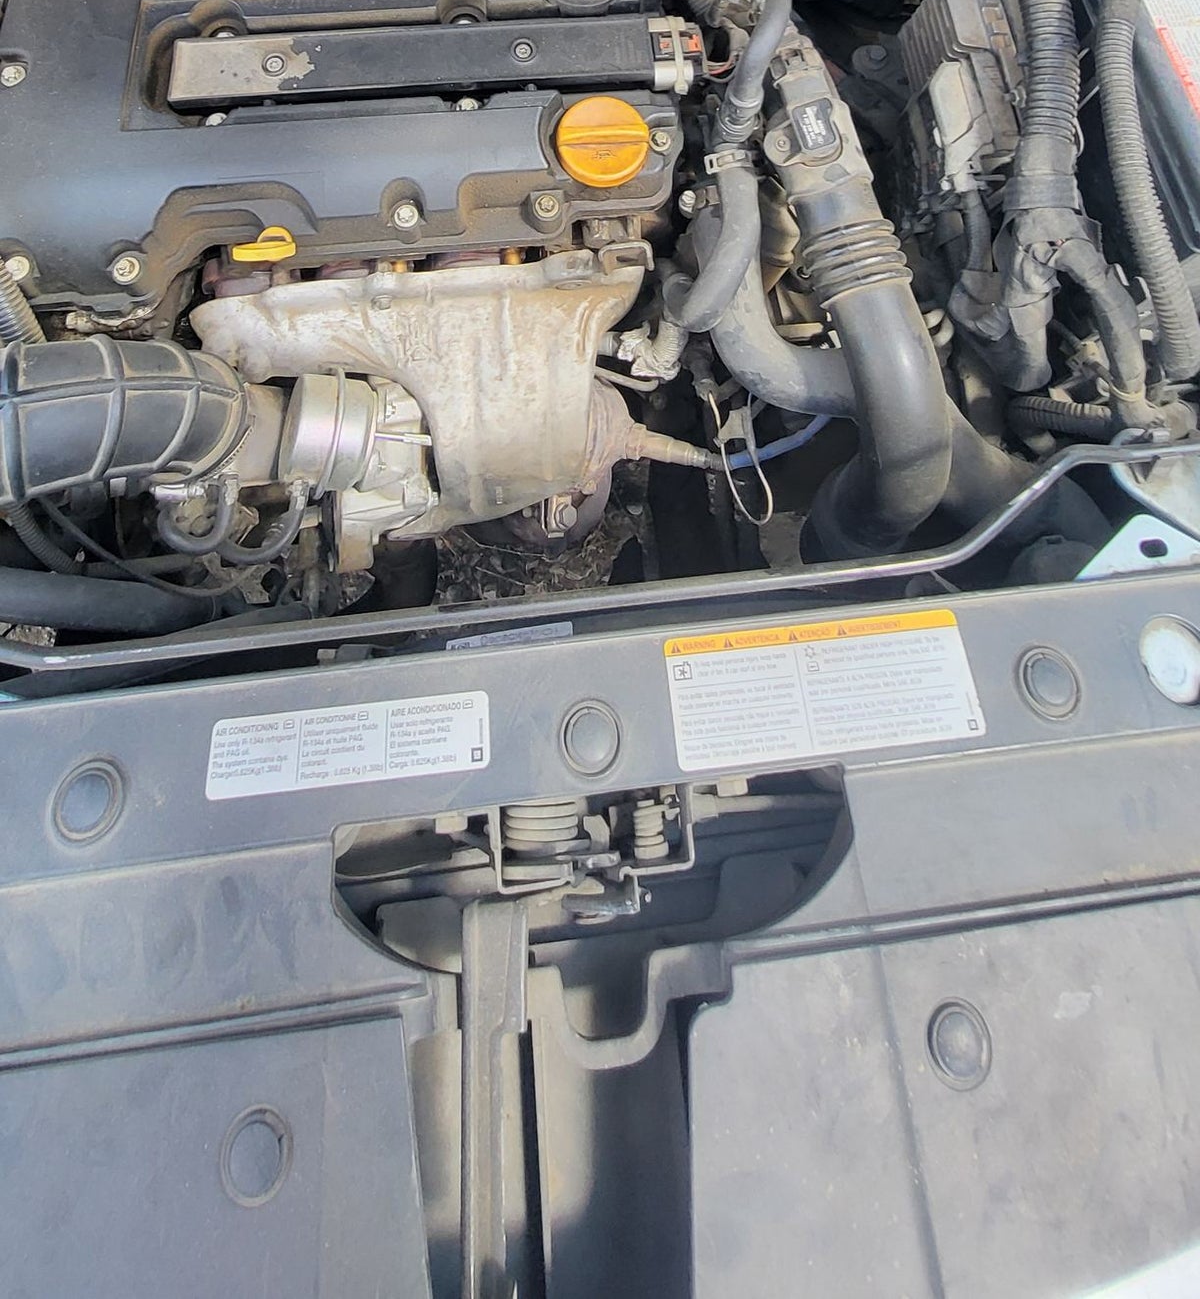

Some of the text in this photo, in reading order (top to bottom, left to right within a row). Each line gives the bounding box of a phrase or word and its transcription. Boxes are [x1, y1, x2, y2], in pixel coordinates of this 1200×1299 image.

[683, 639, 716, 651] WARNING
[391, 701, 461, 717] AIRE ACONDICIONADO
[304, 717, 315, 725] AIR
[215, 722, 278, 737] AIR CONDITIONING
[211, 760, 223, 769] The
